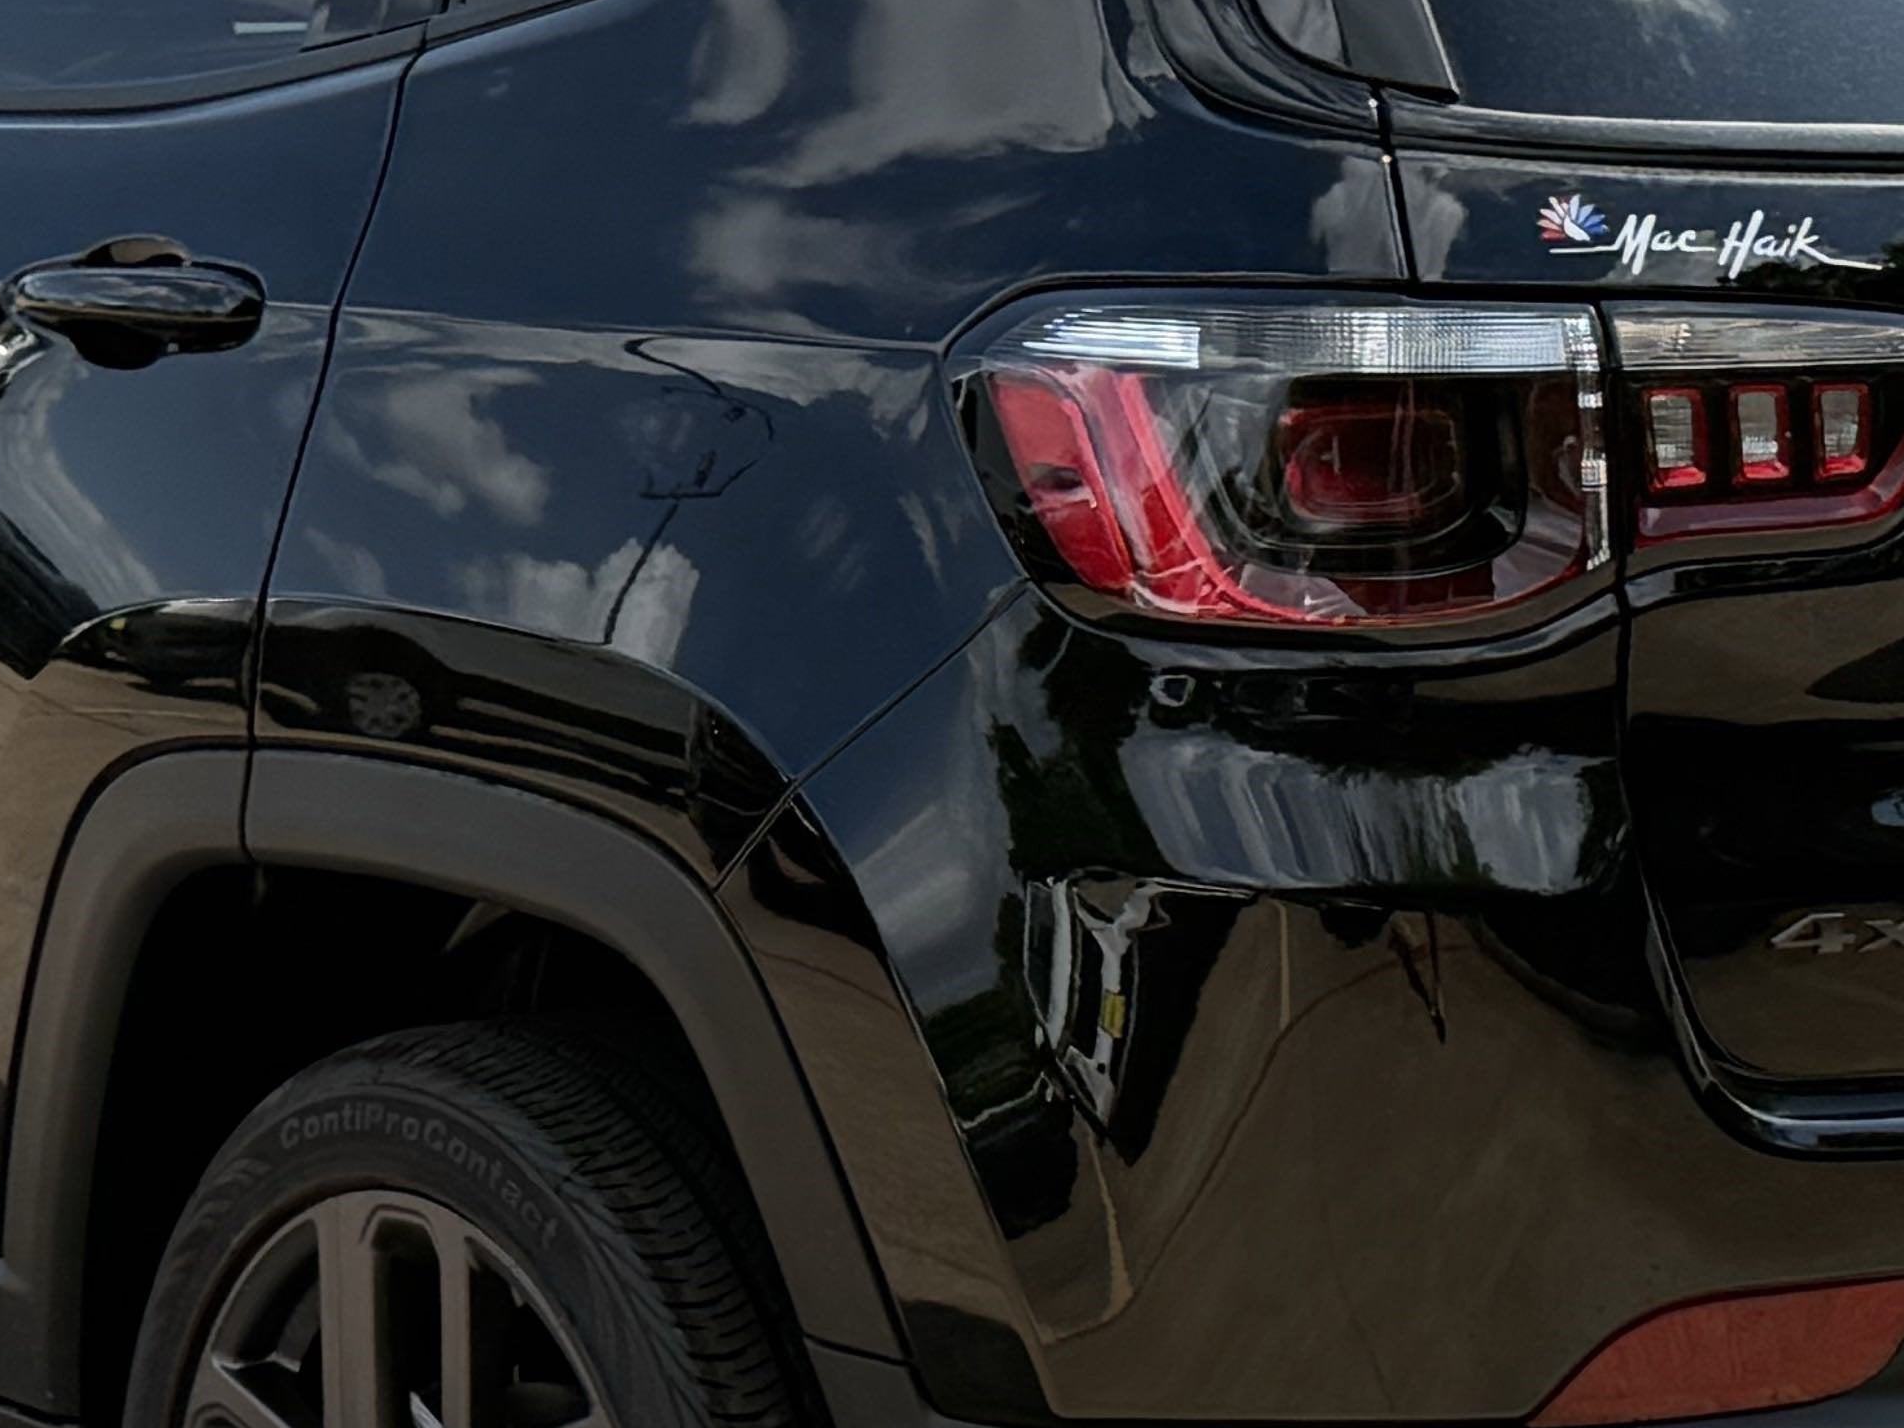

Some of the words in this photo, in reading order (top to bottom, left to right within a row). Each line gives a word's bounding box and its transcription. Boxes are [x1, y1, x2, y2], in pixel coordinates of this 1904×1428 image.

[1549, 213, 1716, 275] Mac
[1716, 209, 1883, 280] Haik
[279, 1102, 560, 1249] ContiProContact
